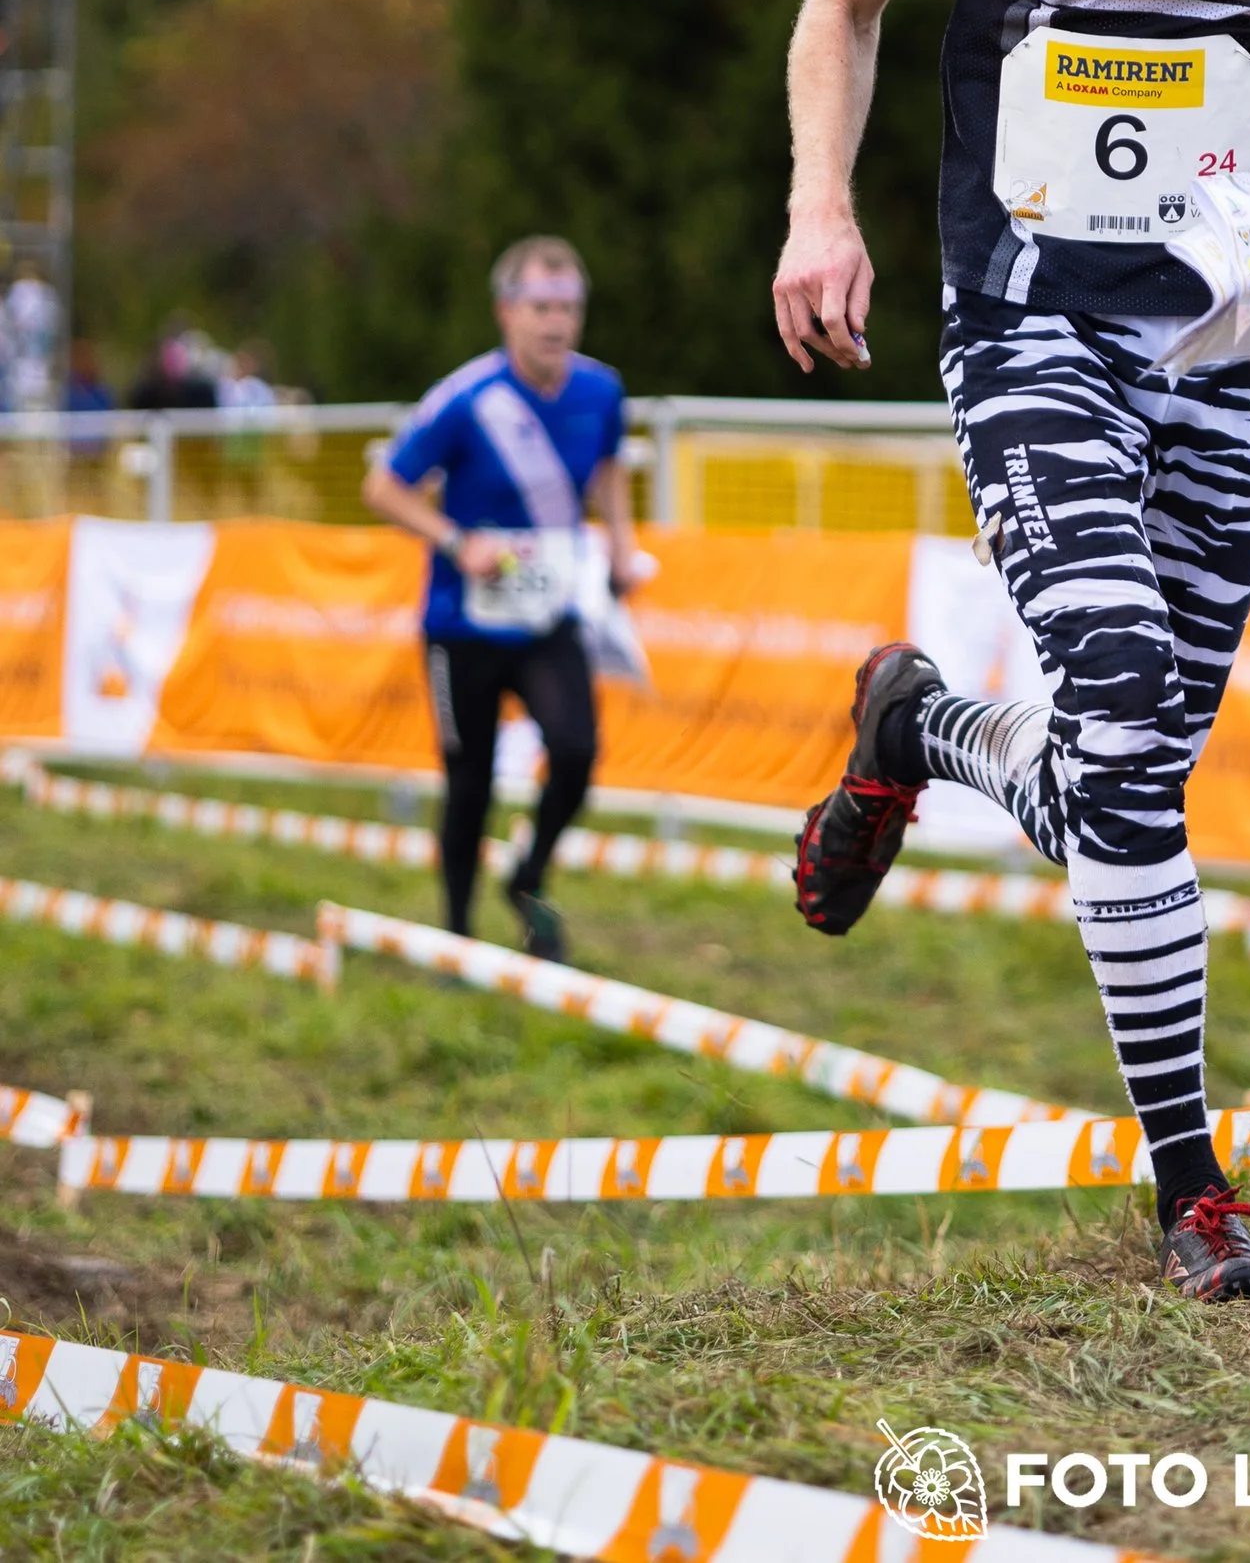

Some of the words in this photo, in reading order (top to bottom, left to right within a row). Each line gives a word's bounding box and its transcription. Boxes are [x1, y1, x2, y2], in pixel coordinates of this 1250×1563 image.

[1057, 54, 1193, 83] RAMIRENT
[1056, 82, 1064, 90] A
[1066, 84, 1109, 95] LOXAM
[1111, 86, 1163, 99] Company
[1094, 114, 1148, 180] 6
[1197, 149, 1237, 177] 24
[1002, 443, 1058, 554] TRIMTEX
[1091, 886, 1197, 915] TRIMTEX
